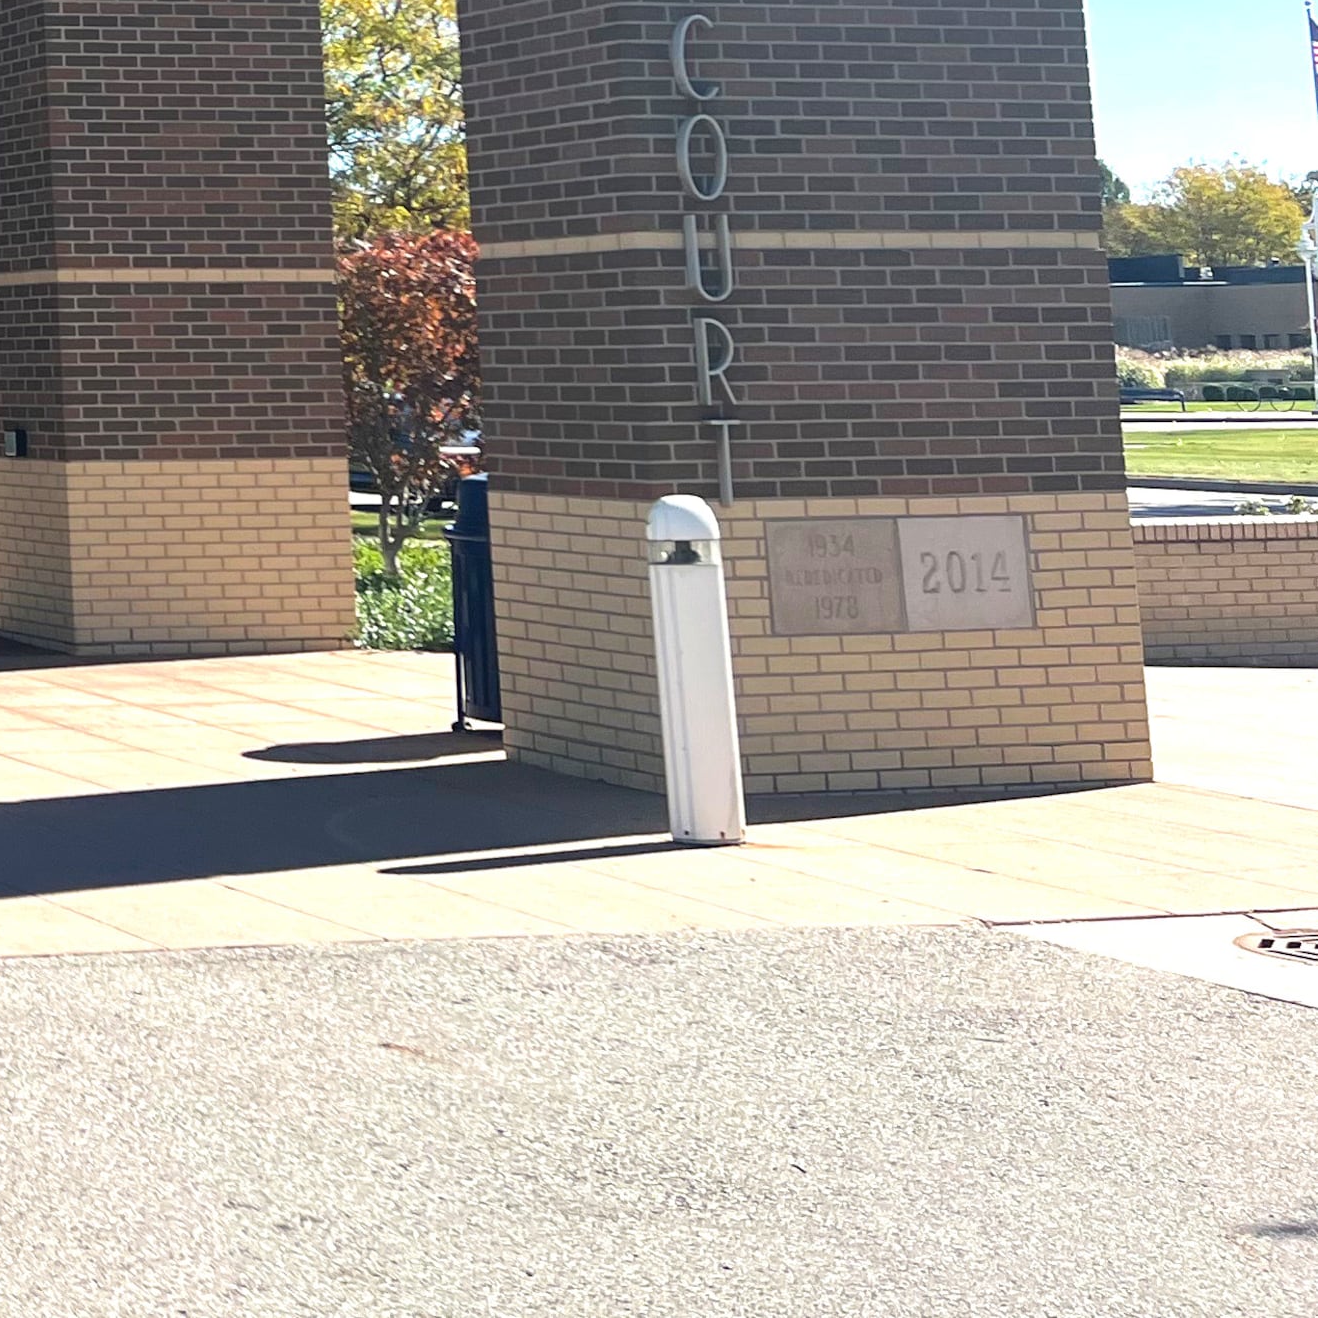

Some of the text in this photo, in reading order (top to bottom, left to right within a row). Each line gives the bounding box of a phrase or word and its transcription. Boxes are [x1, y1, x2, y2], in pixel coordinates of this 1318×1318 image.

[669, 13, 741, 508] COURT
[807, 534, 856, 558] 1934
[920, 550, 1012, 594] 2014
[814, 595, 860, 620] 1978
